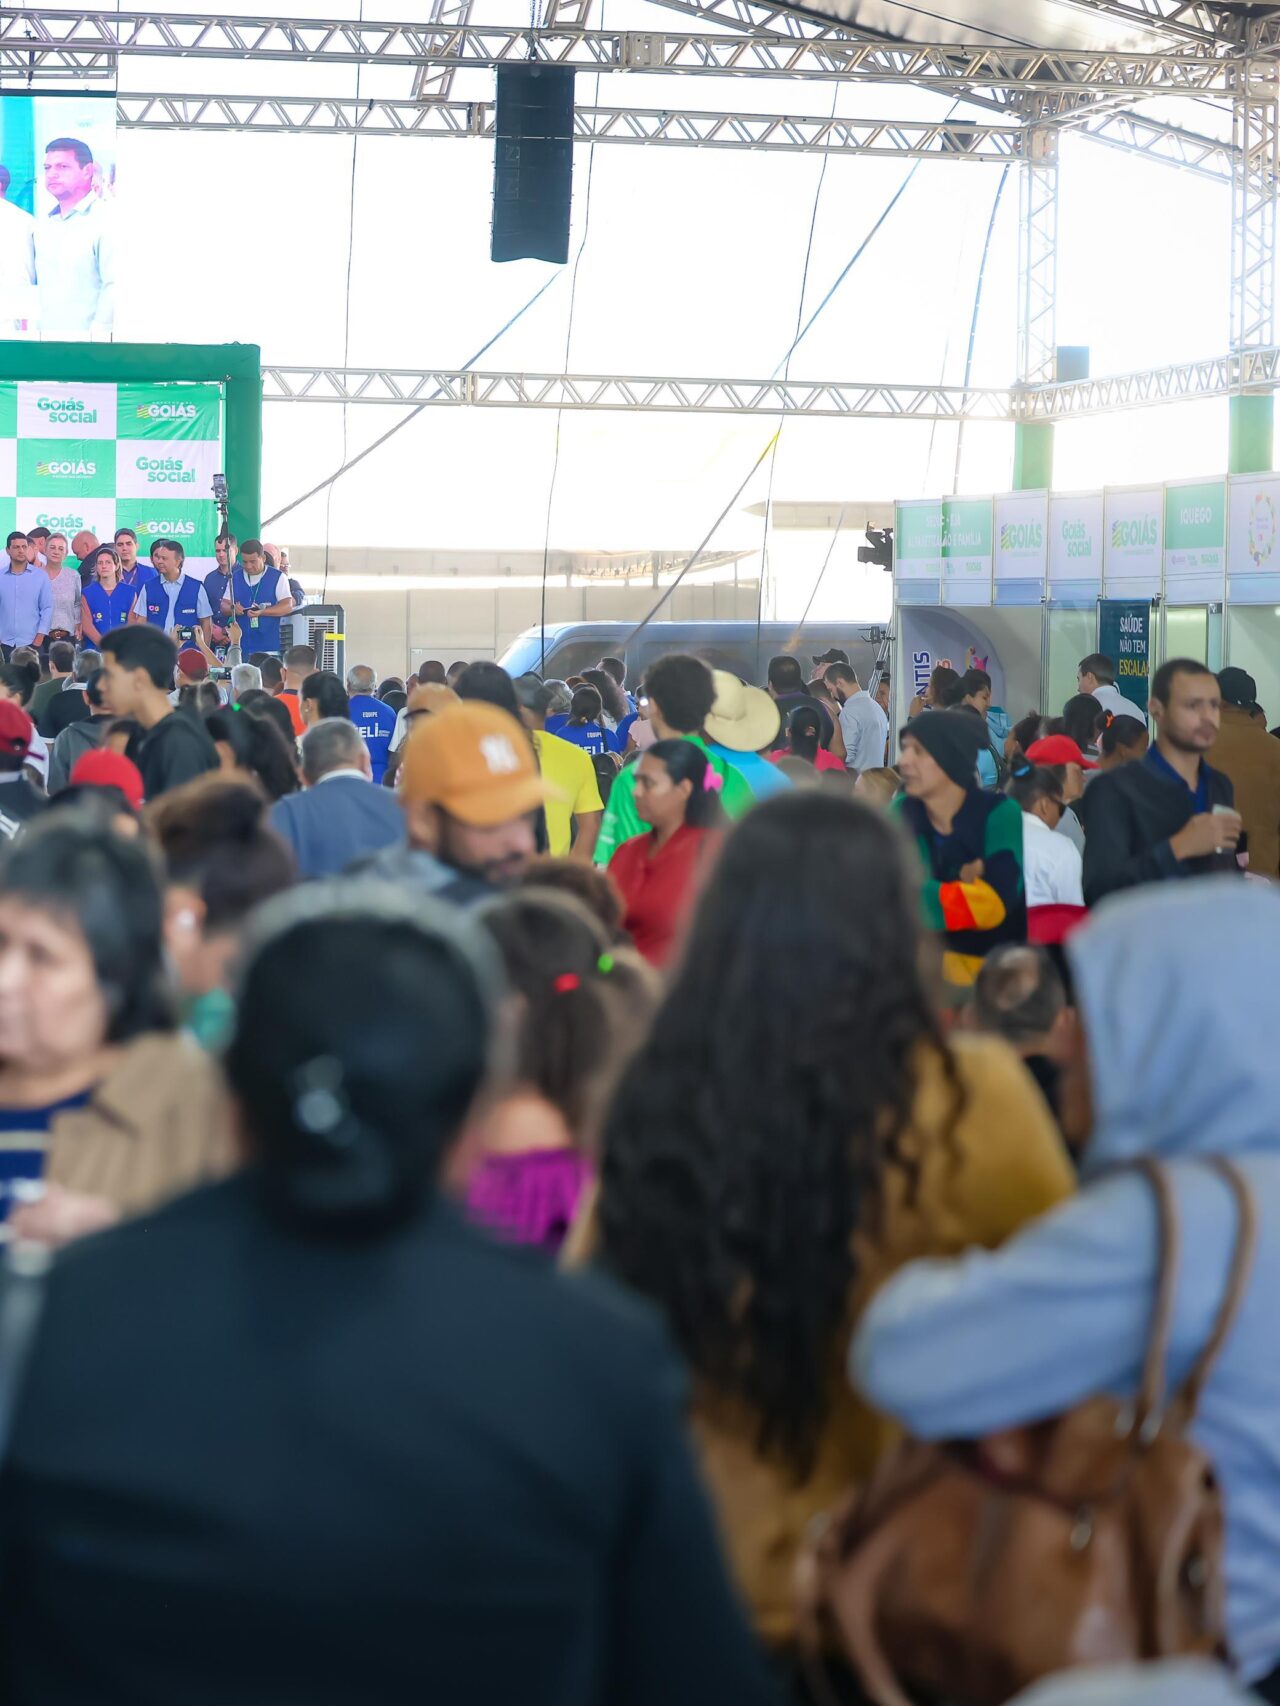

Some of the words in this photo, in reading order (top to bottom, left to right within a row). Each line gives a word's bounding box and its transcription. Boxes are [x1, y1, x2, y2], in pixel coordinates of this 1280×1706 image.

[37, 397, 84, 411] Goiás
[148, 402, 196, 417] GOIÁS
[49, 409, 97, 423] social
[48, 459, 96, 474] GOIÁS
[136, 457, 183, 471] Goiás
[147, 469, 196, 483] social
[36, 514, 83, 528] Goiás
[1180, 506, 1212, 524] IQUEGO
[147, 519, 195, 533] GOIÁS
[1009, 518, 1042, 549] GOIÁS
[1062, 519, 1085, 540] Goiás
[1121, 513, 1158, 546] GOIÁS
[1068, 535, 1092, 557] social
[1120, 613, 1143, 633] SAÚDE
[1120, 636, 1132, 653] NÃO
[1133, 640, 1146, 654] TEM
